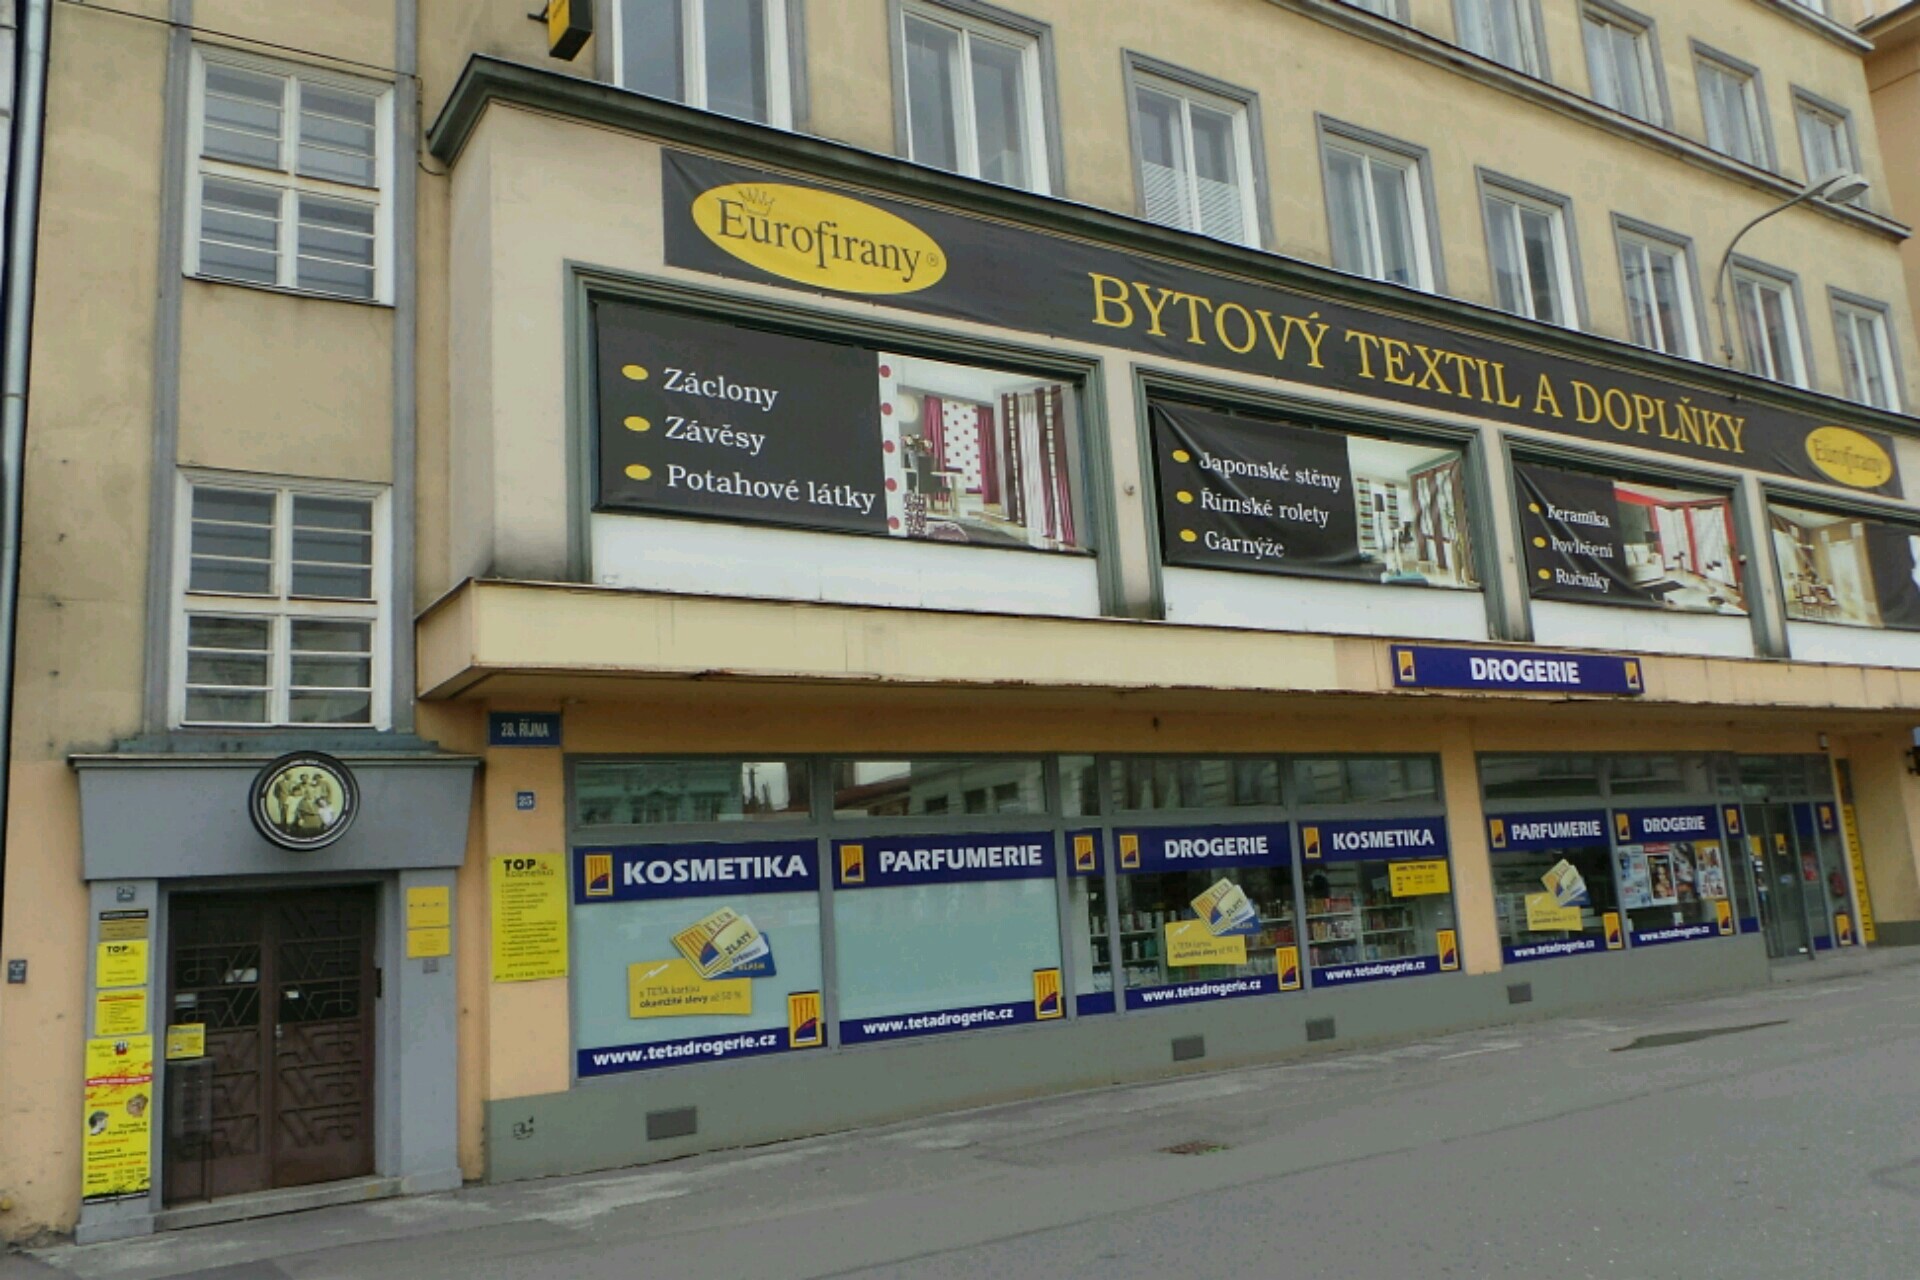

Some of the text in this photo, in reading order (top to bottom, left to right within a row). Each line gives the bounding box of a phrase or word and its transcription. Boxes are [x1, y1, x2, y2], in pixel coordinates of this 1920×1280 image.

[716, 197, 921, 283] Eurofirany
[1088, 272, 1745, 454] BYTOVÝ TEXTIL A DOPLŇKY
[663, 367, 779, 412] Záclony
[665, 416, 765, 456] Závěsy
[1200, 452, 1342, 494] Japonské stěny
[667, 464, 876, 514] Potahové látky
[1201, 487, 1329, 529] Římské rolety
[1547, 503, 1610, 528] Keramika
[1204, 531, 1285, 560] Garnýže
[1469, 657, 1581, 684] DROGERIE
[1511, 820, 1602, 840] PARFUMERIE
[1643, 815, 1706, 833] DROGERIE
[1164, 836, 1268, 859] DROGERIE
[1333, 829, 1434, 851] KOSMETIKA
[504, 859, 536, 871] TOP
[623, 854, 808, 886] KOSMETIKA
[879, 845, 1043, 872] PARFUMERIE
[107, 945, 129, 953] TOP
[1325, 960, 1425, 982] www.tetadrogerie.cz
[1142, 979, 1262, 1003] www.tetadrogerie.cz
[863, 1008, 1013, 1034] www.tetadrogerie.cz
[593, 1033, 777, 1066] www.tetadrogerie.cz
